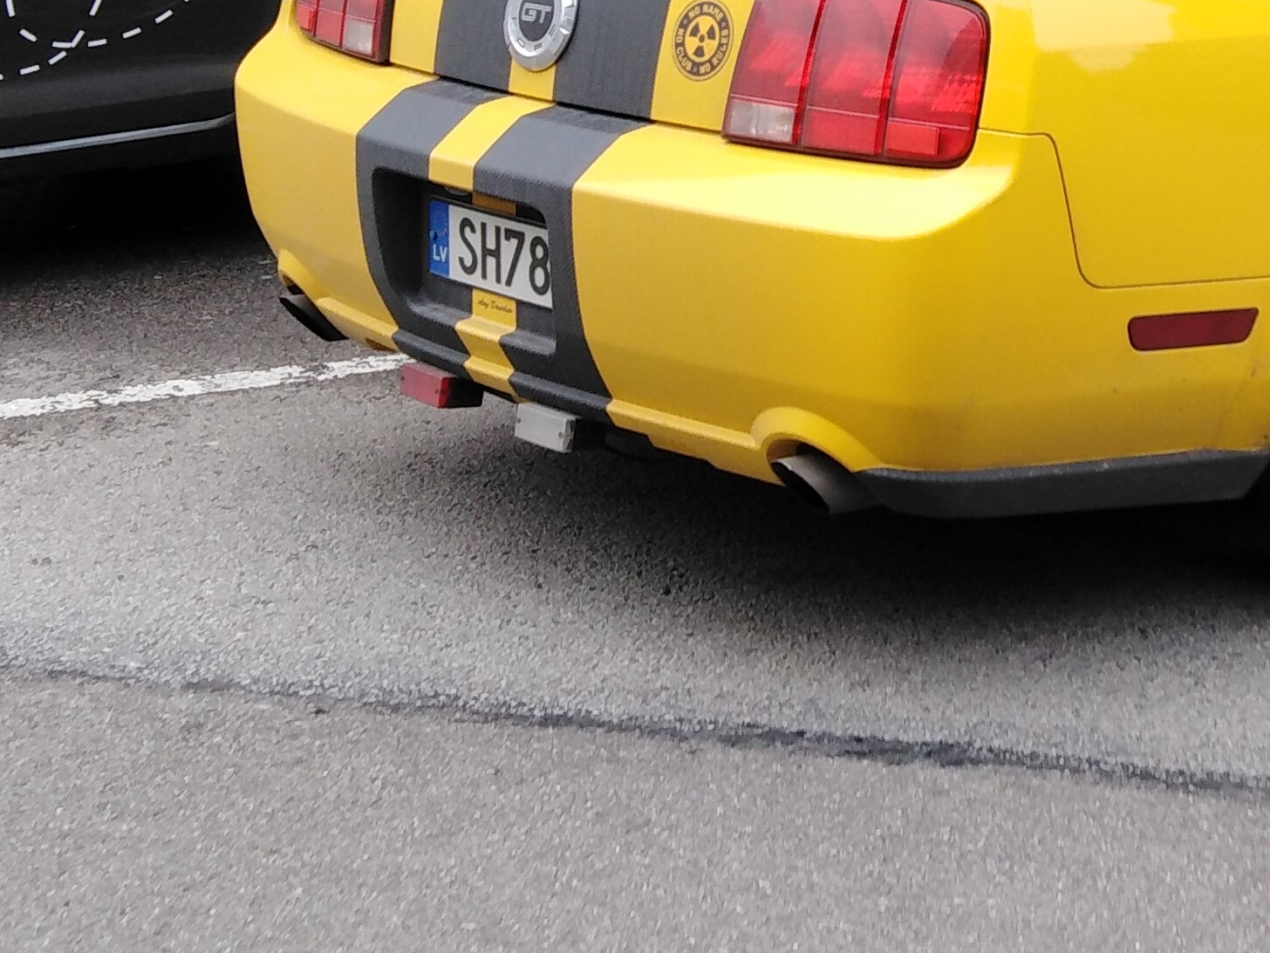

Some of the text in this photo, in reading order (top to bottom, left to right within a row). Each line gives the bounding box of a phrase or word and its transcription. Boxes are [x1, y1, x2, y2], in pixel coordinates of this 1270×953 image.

[521, 2, 552, 24] GT
[688, 4, 724, 21] NO NAME
[676, 46, 693, 71] CLUB
[432, 244, 448, 262] LV
[458, 217, 550, 296] SH78
